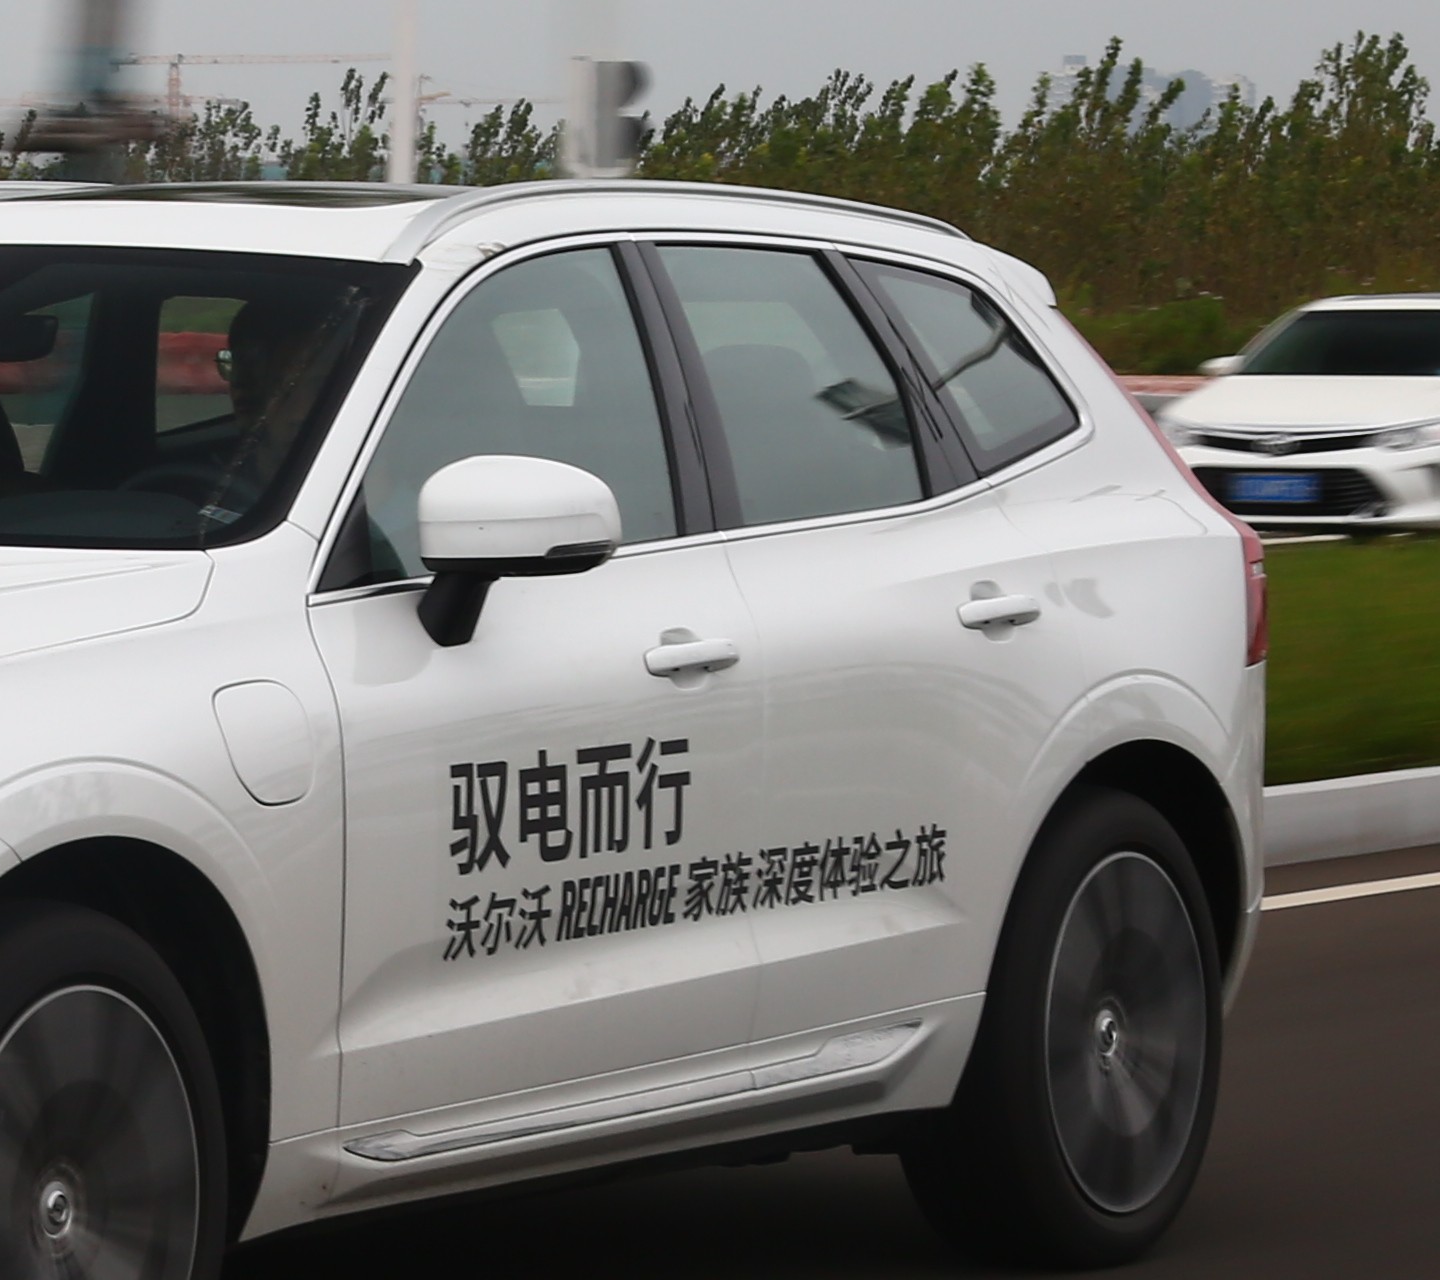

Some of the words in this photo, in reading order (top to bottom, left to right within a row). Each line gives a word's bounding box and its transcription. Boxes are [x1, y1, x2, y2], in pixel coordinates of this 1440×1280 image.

[450, 737, 691, 875] 驭电而行
[443, 884, 552, 961] 沃尔沃
[556, 864, 681, 942] RECHARGE
[682, 823, 947, 919] 家族深度体验之旅
